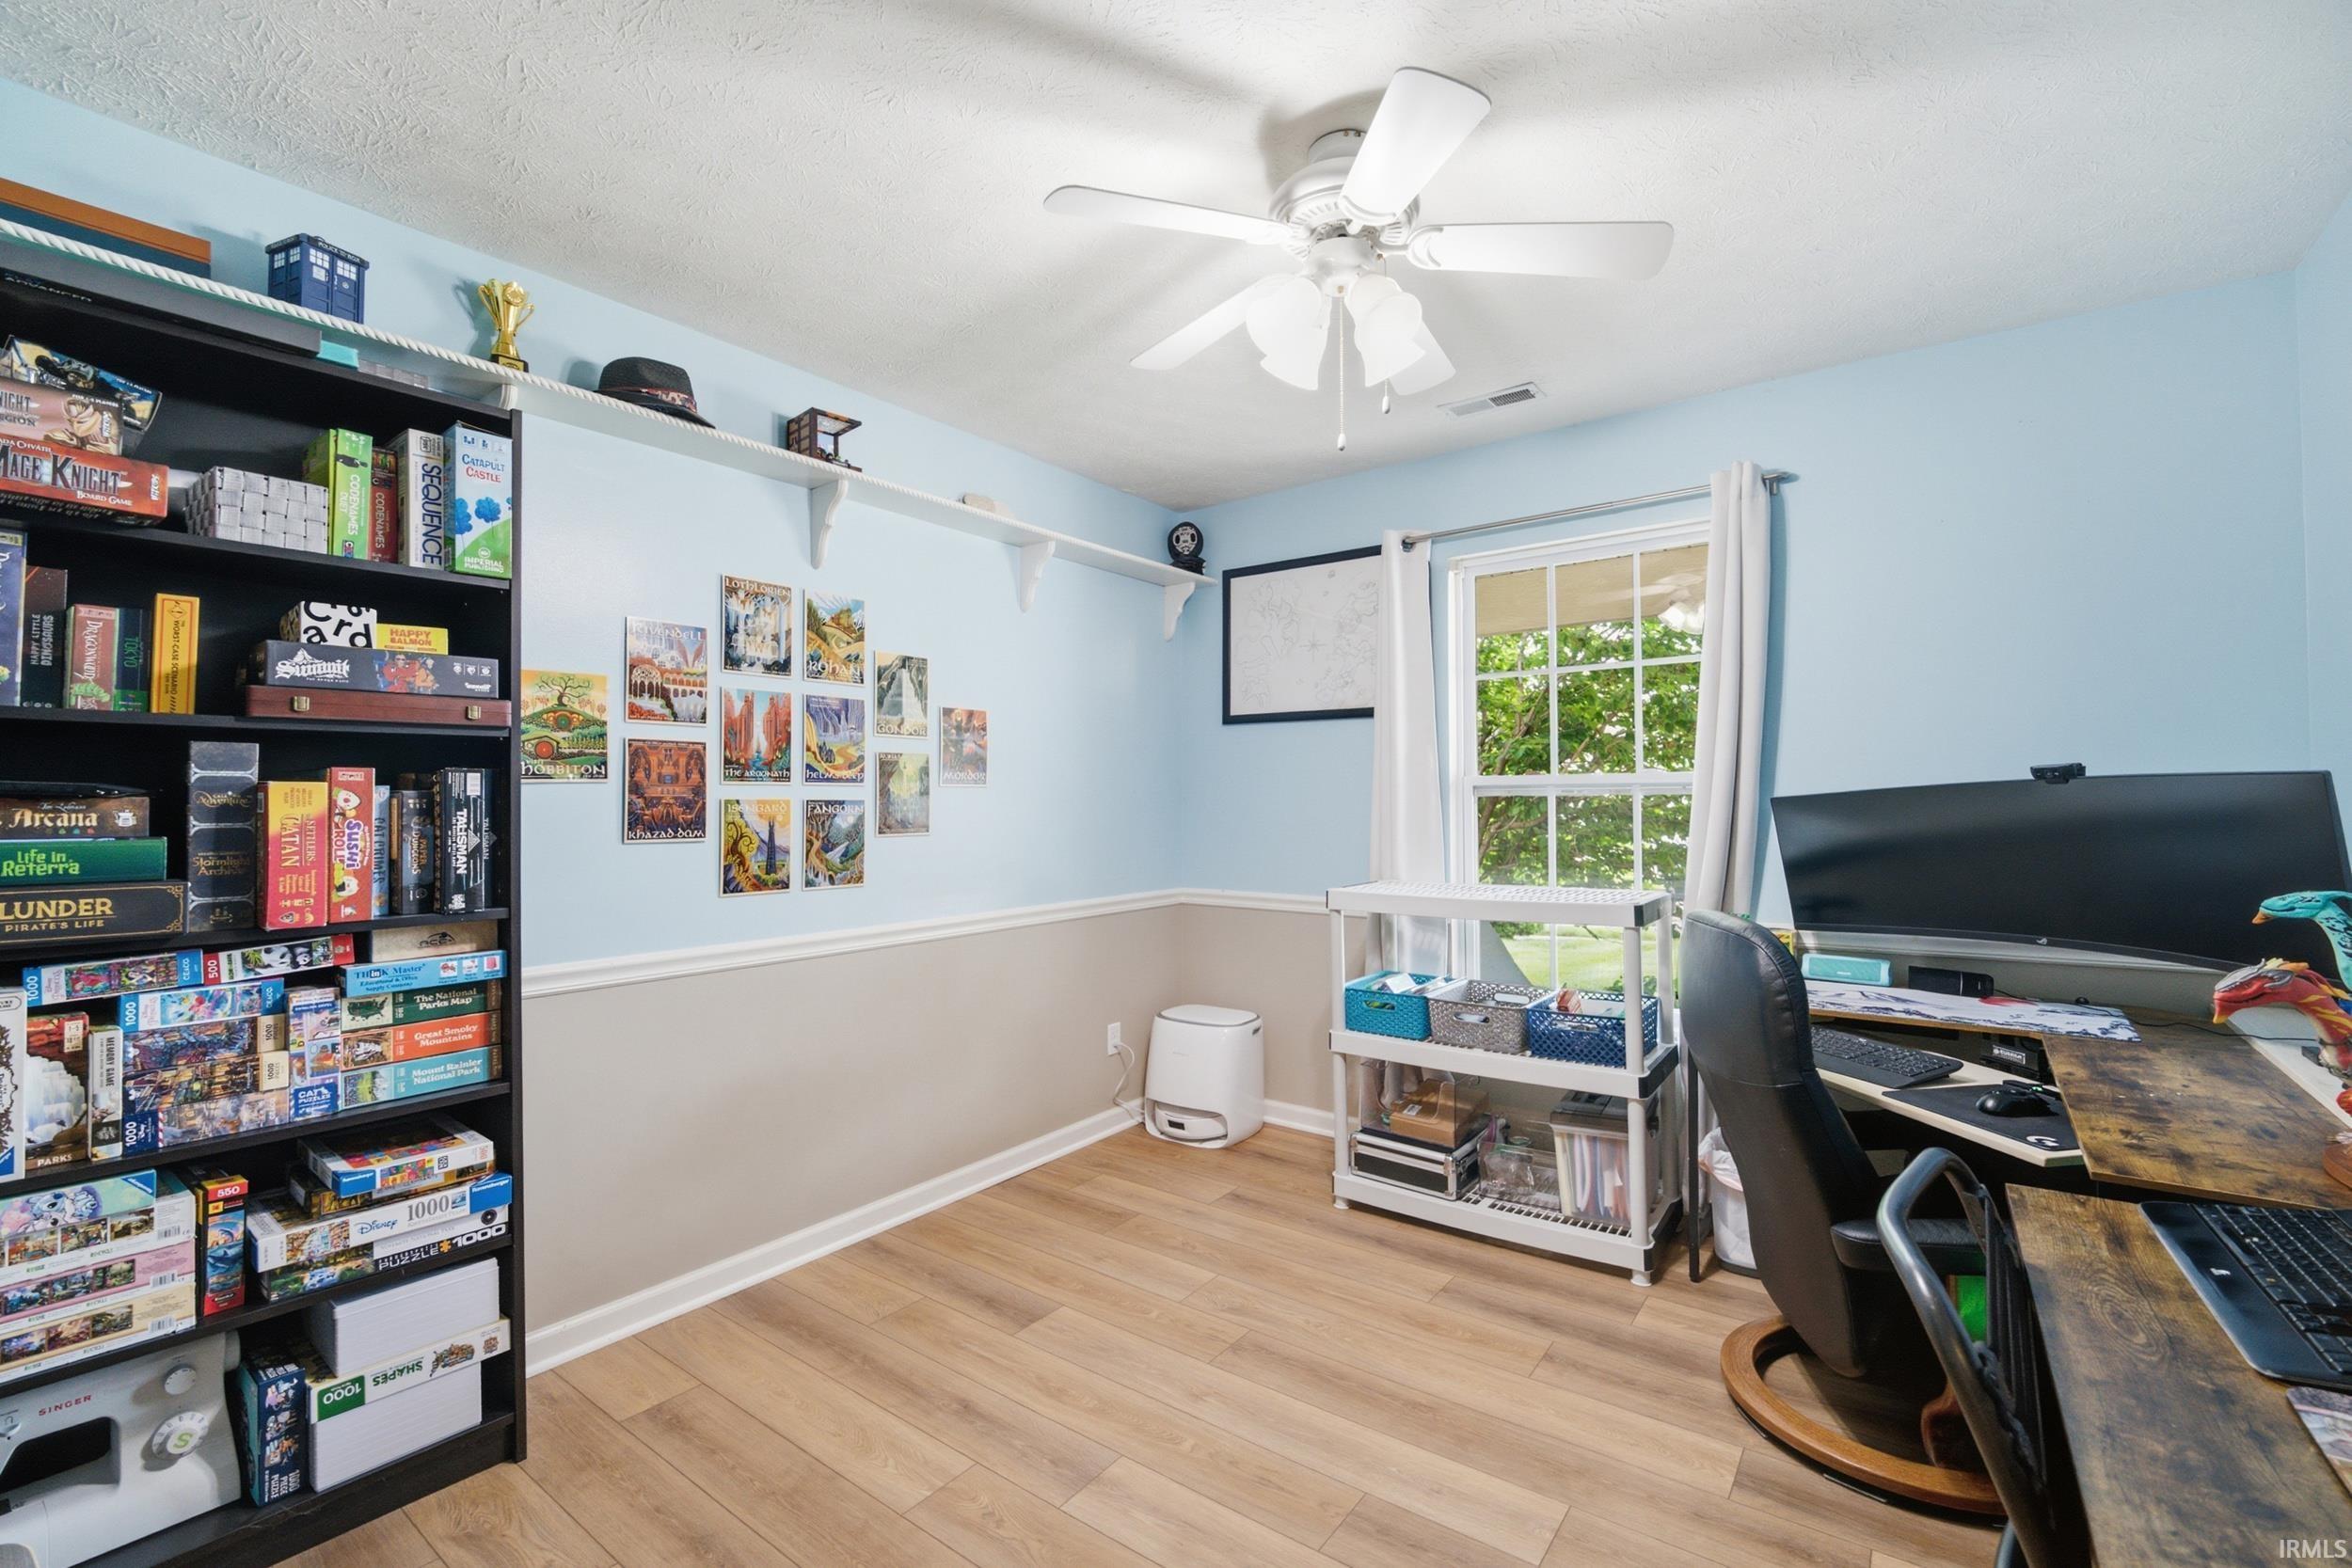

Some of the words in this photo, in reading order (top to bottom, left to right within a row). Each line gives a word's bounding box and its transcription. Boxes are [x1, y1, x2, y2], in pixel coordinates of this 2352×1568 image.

[318, 242, 339, 253] POLICE
[461, 453, 505, 472] CATAPULT
[51, 451, 120, 495] KNIGHT
[466, 467, 501, 483] CASTLE
[76, 490, 106, 502] BOARD
[108, 496, 133, 506] GAME
[348, 474, 360, 535] CODENAMES
[374, 492, 385, 548] CODENAMES
[421, 463, 442, 565] SEQUENCE
[725, 577, 791, 596] LOTHLORIEN
[171, 620, 181, 661] WORST-CASE
[389, 628, 432, 640] HAPPY
[632, 623, 704, 641] RIVENDELL
[389, 637, 432, 647] SALMON
[30, 641, 40, 665] HAPPY
[123, 636, 138, 668] TOKYO
[808, 660, 861, 677] ROHAN
[170, 662, 179, 695] SCENARIO
[877, 723, 927, 736] GONDOR
[520, 760, 606, 775] HOBBITON
[725, 768, 743, 777] THE
[744, 768, 790, 778] ARGONATH
[943, 768, 986, 781] MORDOR
[727, 800, 787, 813] ISENGARD
[807, 804, 864, 816] FANGORN
[8, 808, 99, 828] Arcana
[280, 816, 300, 867] CATAN
[306, 820, 316, 862] SETTLERS
[334, 830, 345, 862] ROLL
[346, 820, 362, 869] SUSHI
[456, 808, 468, 875] TALISMAN
[17, 848, 46, 863] Life
[51, 851, 67, 863] in
[193, 855, 250, 867] Stormlight
[374, 840, 387, 884] CRIMES
[2, 858, 80, 878] Reterra
[5, 922, 69, 932] PIRATE'S
[74, 919, 104, 928] LIFE
[207, 959, 218, 979] 500
[392, 965, 422, 974] Master
[27, 975, 39, 1001] 1000
[436, 988, 477, 1002] National
[420, 1000, 449, 1010] Parks
[451, 997, 472, 1006] Map
[125, 1002, 136, 1026] 1000
[415, 1030, 443, 1040] Great
[444, 1024, 478, 1036] Smoky
[420, 1033, 473, 1047] Mountains
[105, 1037, 115, 1065] MEMORY
[105, 1067, 115, 1087] GAME
[413, 1066, 445, 1077] Mount
[447, 1059, 483, 1069] Rainier
[414, 1071, 456, 1085] National
[457, 1067, 481, 1077] Park
[124, 1121, 137, 1147] 1000
[37, 1153, 72, 1167] PARKS
[217, 1185, 240, 1197] 550
[407, 1195, 450, 1222] 1000
[358, 1219, 398, 1234] Disney
[379, 1248, 439, 1271] PUZZLE
[453, 1224, 507, 1247] 1000
[373, 1360, 423, 1386] SHAPES
[323, 1382, 362, 1405] 1000
[39, 1394, 92, 1417] SINGER
